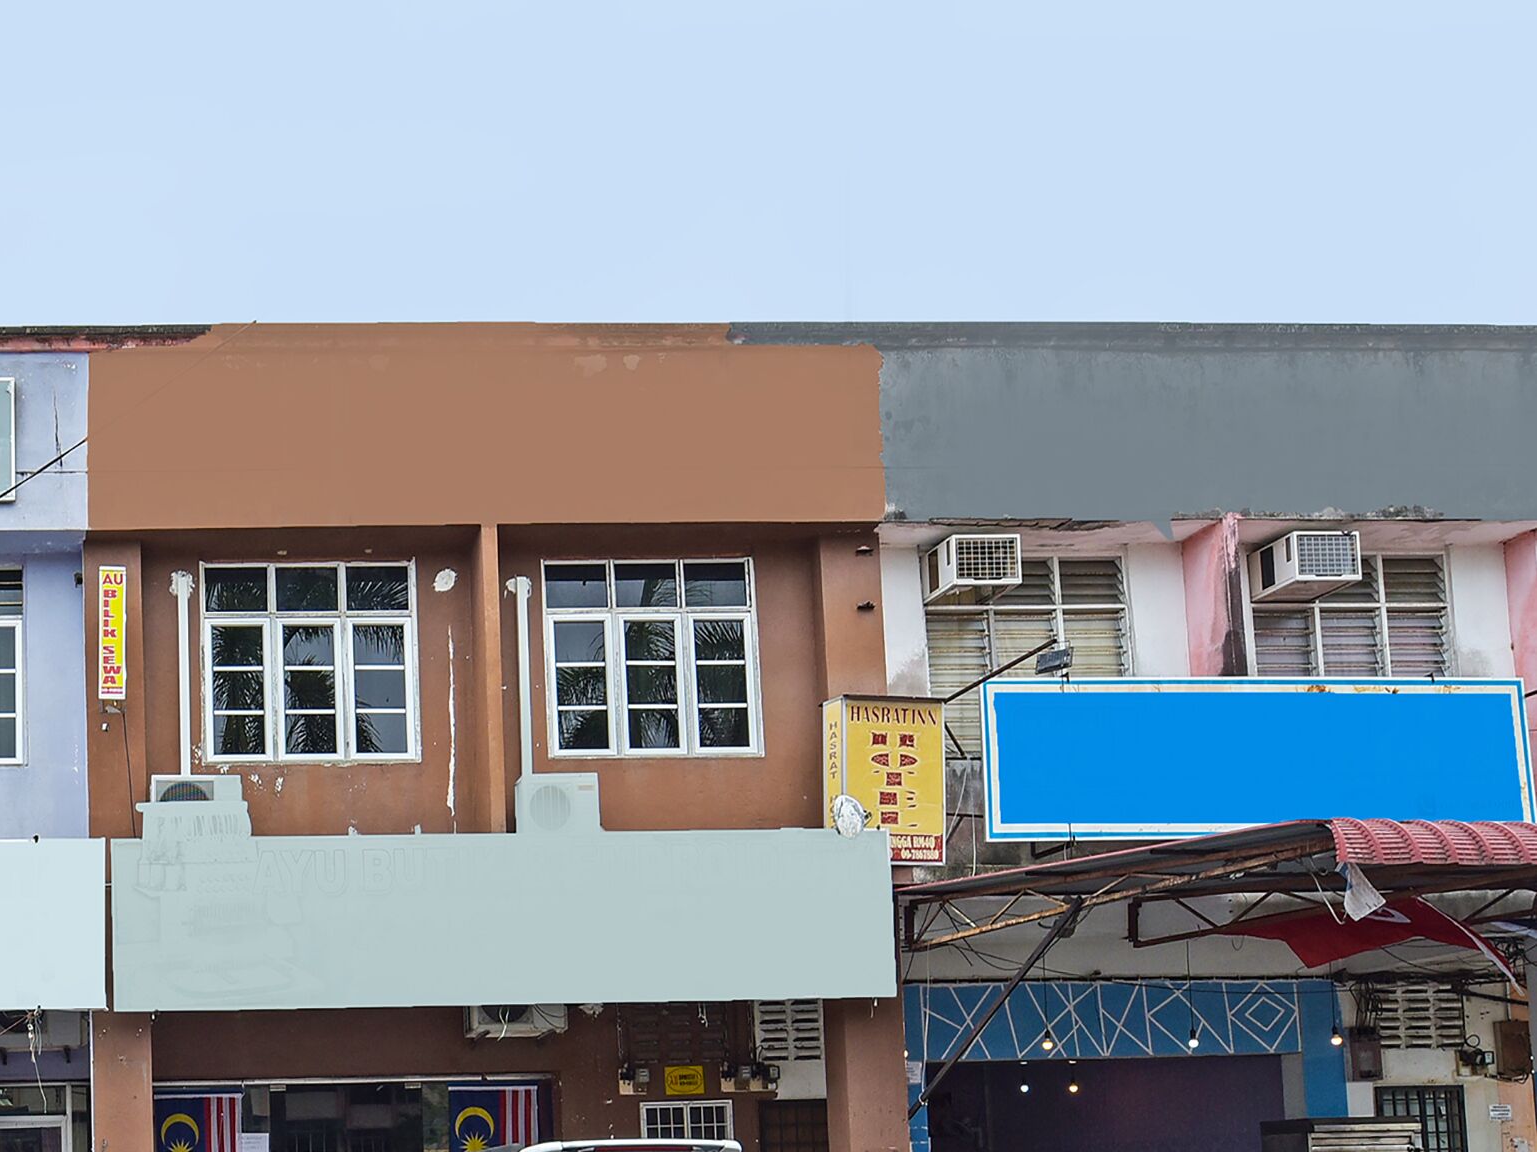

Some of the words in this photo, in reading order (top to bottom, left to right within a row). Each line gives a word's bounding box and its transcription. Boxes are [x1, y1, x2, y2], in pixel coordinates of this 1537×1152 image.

[103, 573, 123, 585] AU
[102, 589, 117, 638] BILIK
[102, 646, 122, 685] SEWA
[850, 705, 909, 725] HASRAT
[911, 709, 938, 726] INN
[829, 721, 838, 780] HASRAT
